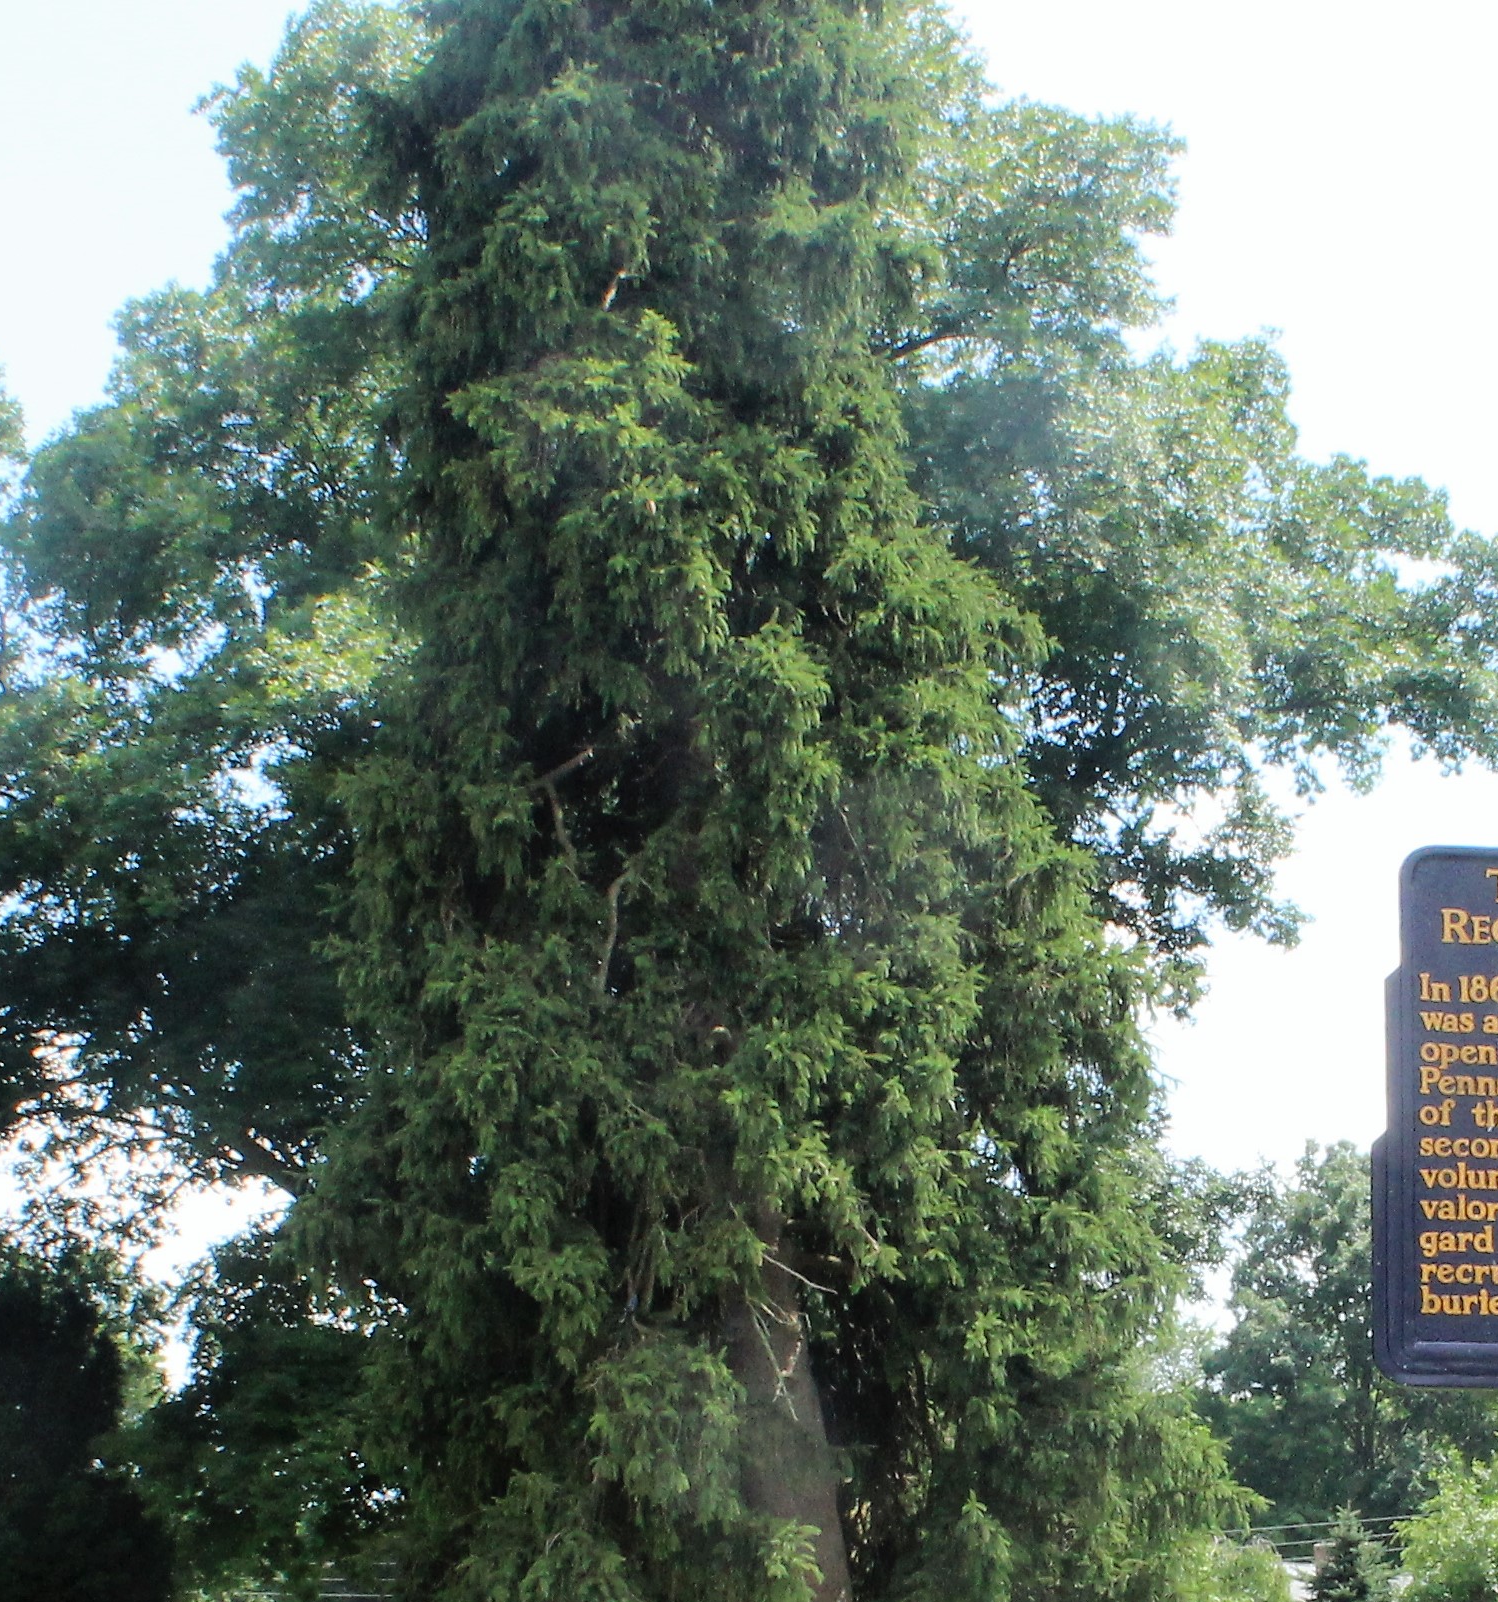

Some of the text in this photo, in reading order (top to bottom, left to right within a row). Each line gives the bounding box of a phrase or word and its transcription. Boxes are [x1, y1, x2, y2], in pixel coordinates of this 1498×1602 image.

[1419, 973, 1450, 1002] In
[1419, 1011, 1474, 1033] was
[1420, 1042, 1498, 1069] open
[1419, 1100, 1455, 1127] of
[1419, 1226, 1494, 1257] gard
